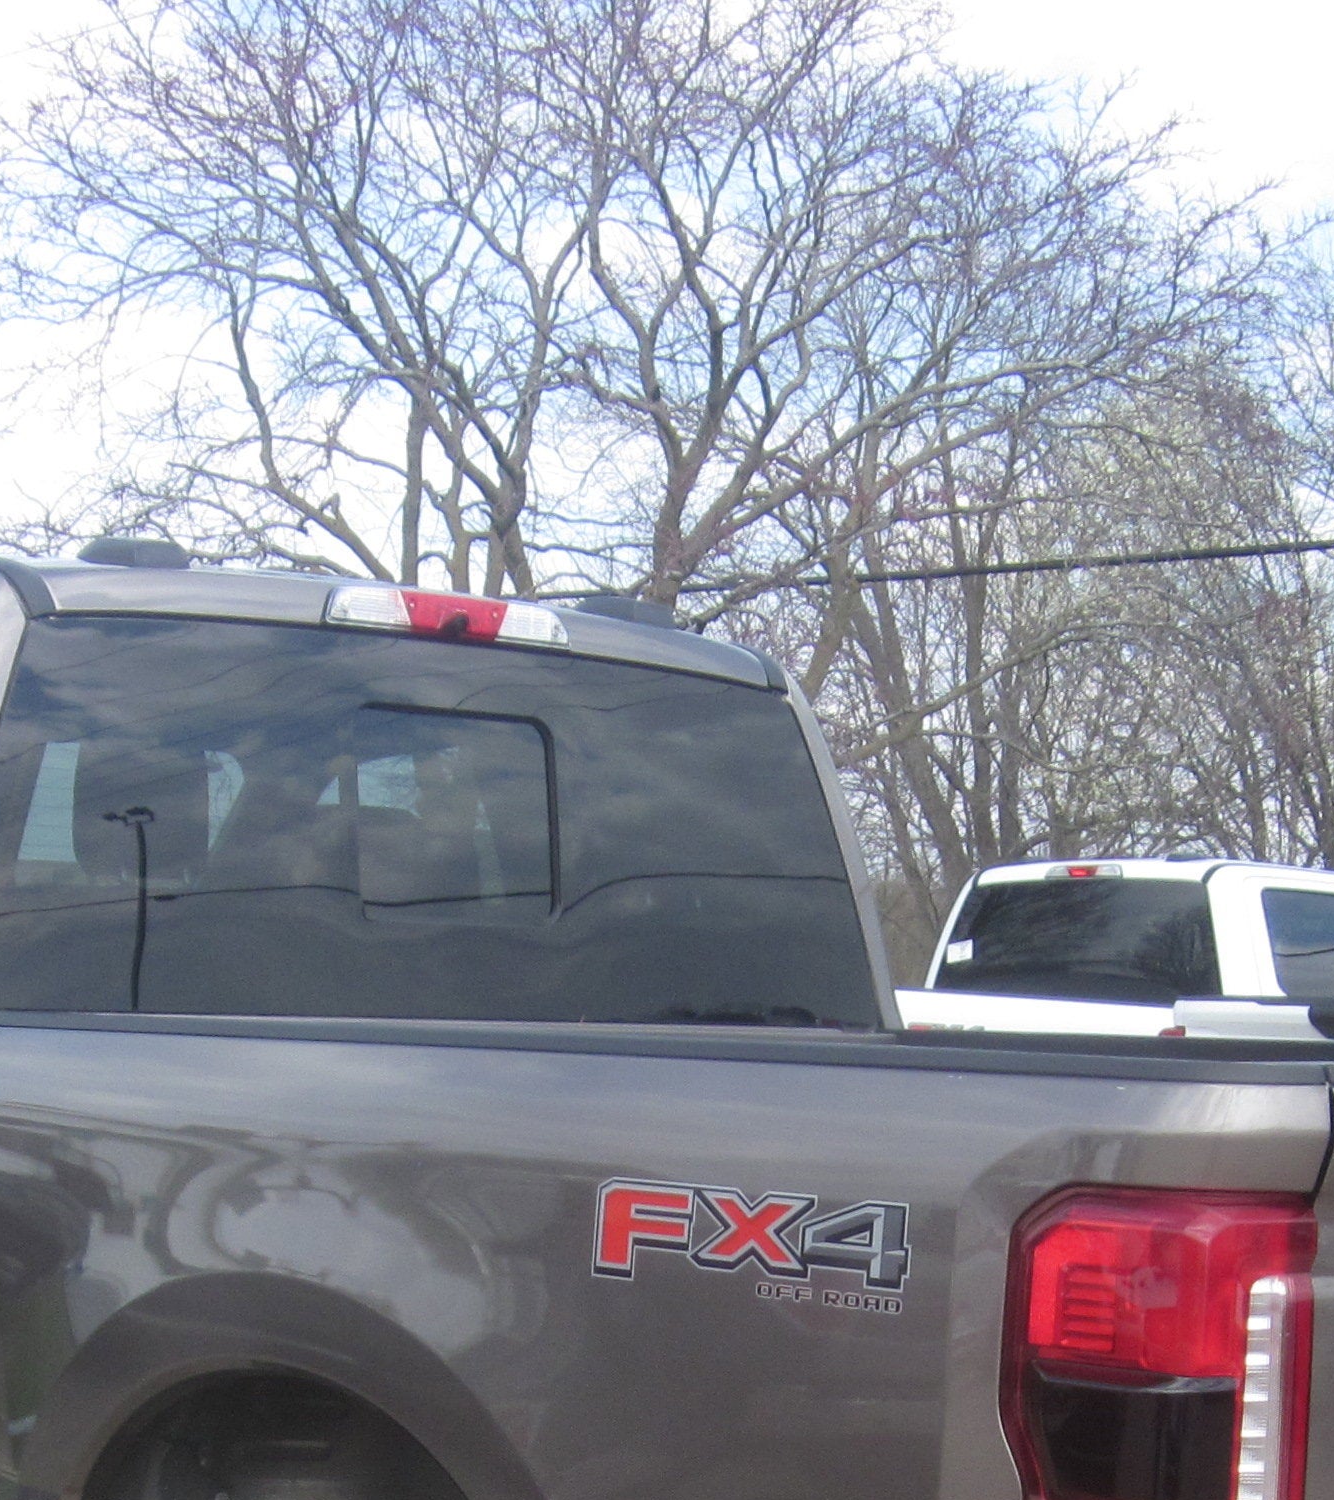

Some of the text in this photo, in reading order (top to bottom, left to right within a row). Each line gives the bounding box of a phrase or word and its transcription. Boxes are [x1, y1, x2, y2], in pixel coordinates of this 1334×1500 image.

[592, 1177, 911, 1292] FX4
[756, 1282, 903, 1314] OFF ROAD
